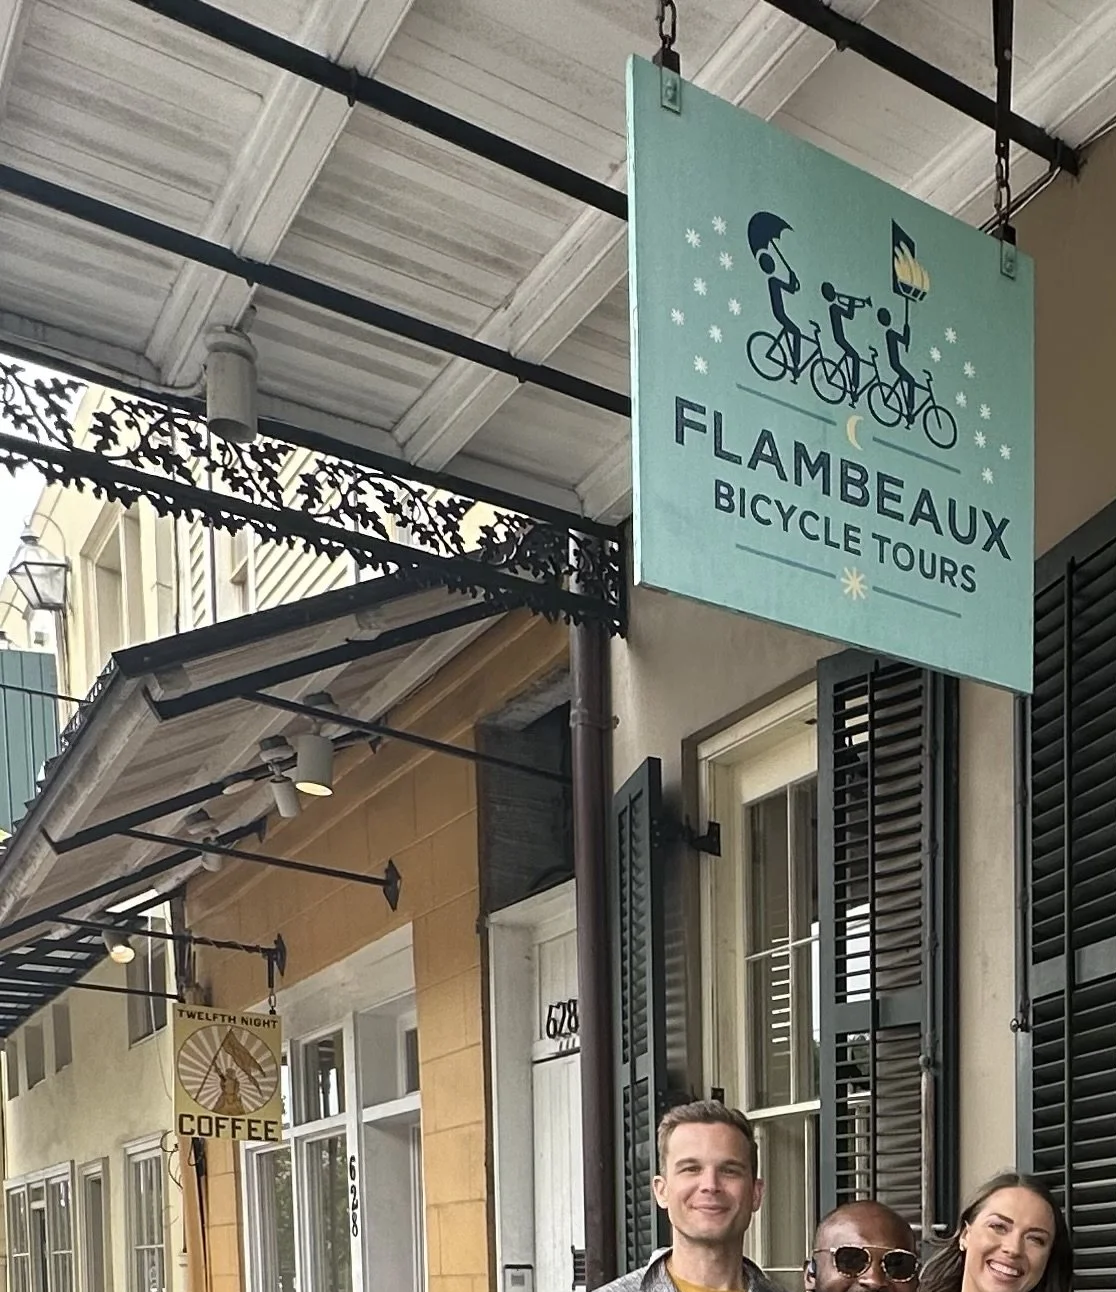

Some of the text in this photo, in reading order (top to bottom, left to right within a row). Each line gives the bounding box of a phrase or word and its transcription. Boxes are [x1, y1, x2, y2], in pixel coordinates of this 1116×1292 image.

[675, 396, 1011, 560] FLAMBEAUX
[714, 479, 977, 593] BICYCLE TOURS
[177, 1008, 278, 1029] TWELFTH NIGHT
[546, 999, 579, 1039] 628
[178, 1113, 279, 1142] COFFEE
[349, 1155, 359, 1238] 628
